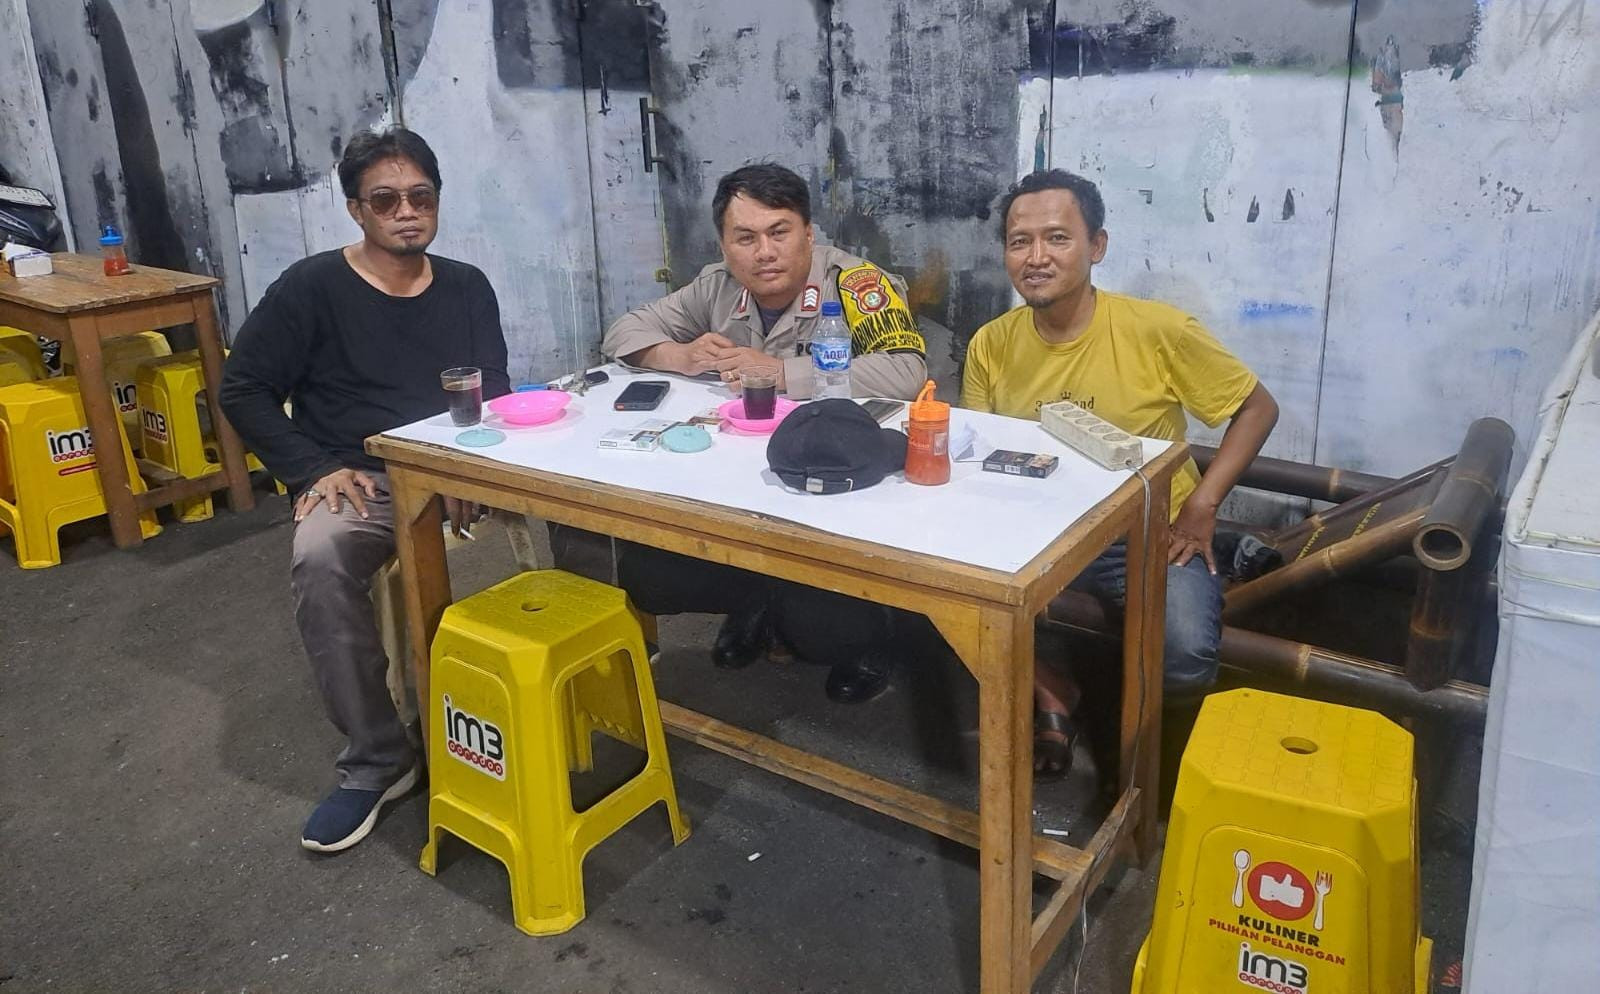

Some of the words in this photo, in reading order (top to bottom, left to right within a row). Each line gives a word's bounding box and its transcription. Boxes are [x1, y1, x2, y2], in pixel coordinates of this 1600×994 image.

[823, 349, 848, 360] AQUA
[141, 403, 166, 433] im3
[53, 448, 95, 462] ooredo
[444, 694, 504, 761] im3
[1208, 918, 1259, 941] PILIHAN
[1262, 935, 1346, 966] PELANGGAN
[1238, 914, 1320, 948] KULINER
[1241, 942, 1308, 989] im3
